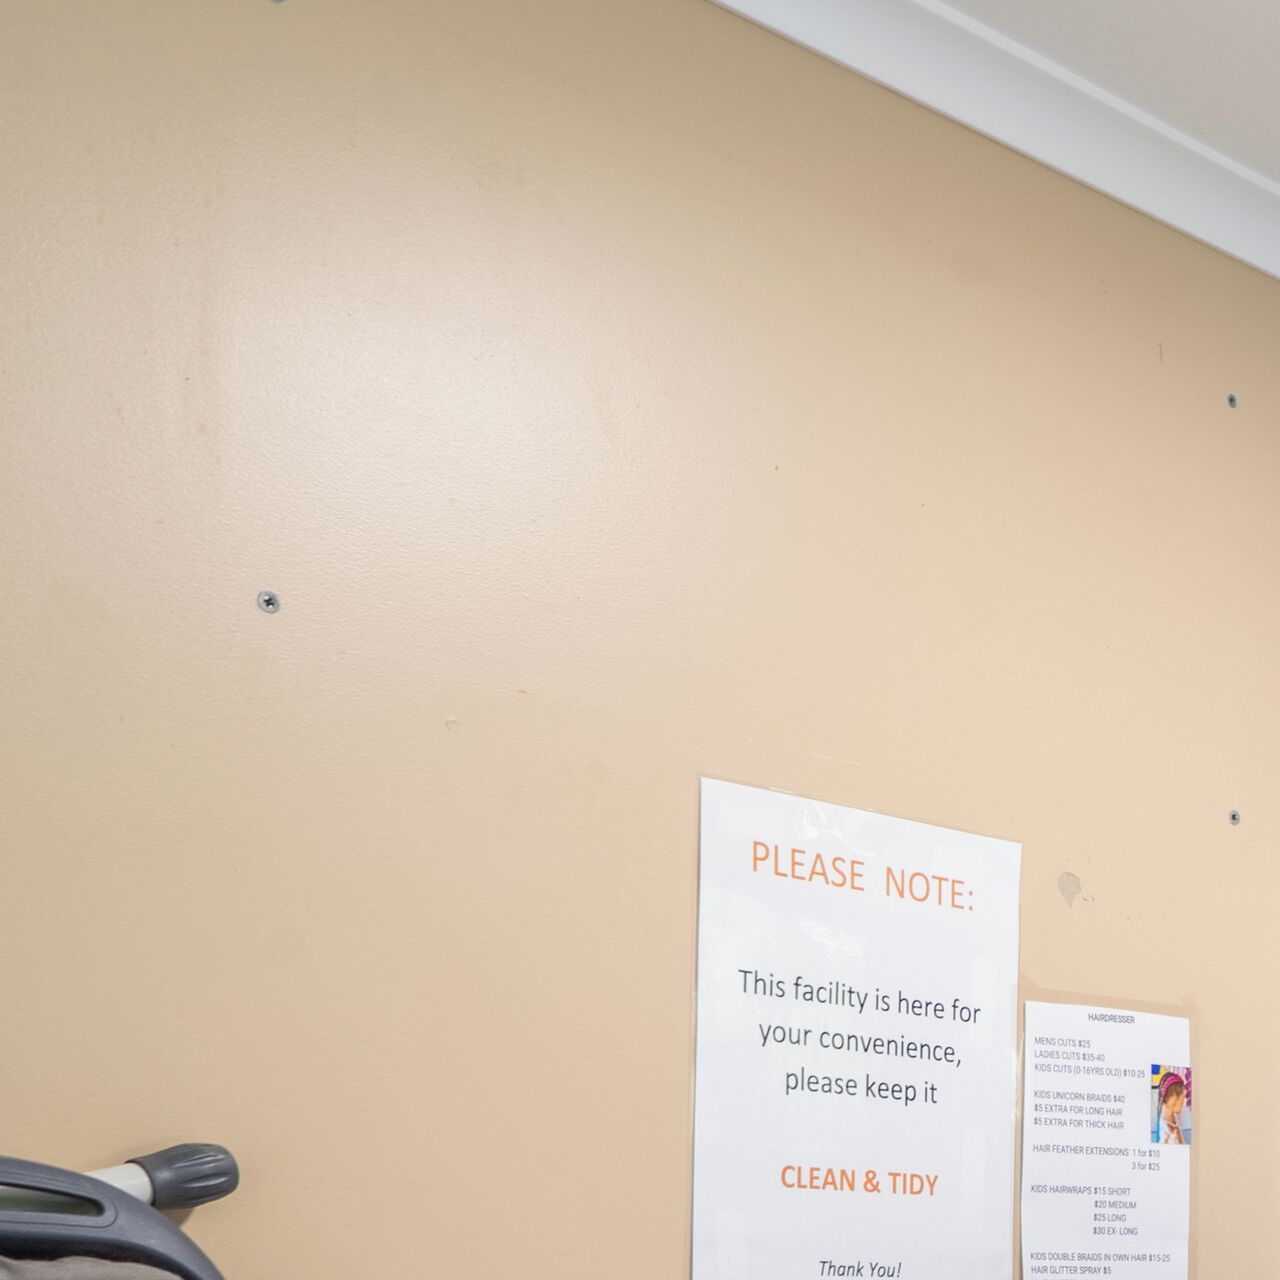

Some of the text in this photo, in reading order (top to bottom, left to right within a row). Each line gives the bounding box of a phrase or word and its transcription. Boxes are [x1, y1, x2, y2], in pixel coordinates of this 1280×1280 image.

[752, 841, 974, 911] PLEASE NOTE:
[739, 969, 981, 1024] This facility is here for
[1088, 1013, 1135, 1023] HAIRDRESSER
[759, 1022, 961, 1068] your convenience,
[1035, 1037, 1090, 1048] MENS CUTS $25
[1035, 1051, 1059, 1060] LADIES
[1062, 1052, 1080, 1060] CUTS
[1035, 1064, 1051, 1072] KIDS
[1053, 1065, 1072, 1073] CUTS
[1106, 1068, 1121, 1077] OLD)
[785, 1068, 937, 1106] please keep it
[1034, 1091, 1050, 1099] KIDS
[1053, 1092, 1085, 1101] UNICORN
[1087, 1093, 1111, 1102] BRAIDS
[1034, 1104, 1122, 1116] $5 EXTRA FOR LONG HAIR
[1034, 1118, 1124, 1129] $5 EXTRA FOR THICK HAIR
[1033, 1144, 1050, 1153] HAIR
[1052, 1145, 1084, 1155] FEATHER
[1086, 1146, 1129, 1157] EXTENSIONS
[1138, 1148, 1147, 1157] for
[1149, 1149, 1160, 1158] $10
[1138, 1162, 1146, 1170] for
[1149, 1162, 1160, 1171] $25
[780, 1165, 938, 1196] CLEAN & TIDY
[1031, 1185, 1130, 1195] KIDS HAIRWRAPS $15 SHORT
[1094, 1201, 1136, 1209] $20 MEDIUM
[1094, 1214, 1126, 1222] $25 LONG
[1049, 1253, 1075, 1261] DOUBLE
[1077, 1253, 1101, 1261] BRAIDS
[1113, 1254, 1129, 1262] OWN
[1131, 1254, 1147, 1262] HAIR
[819, 1260, 901, 1279] Thank You!
[1032, 1266, 1111, 1275] HAIR GLITTER SPRAY $5
